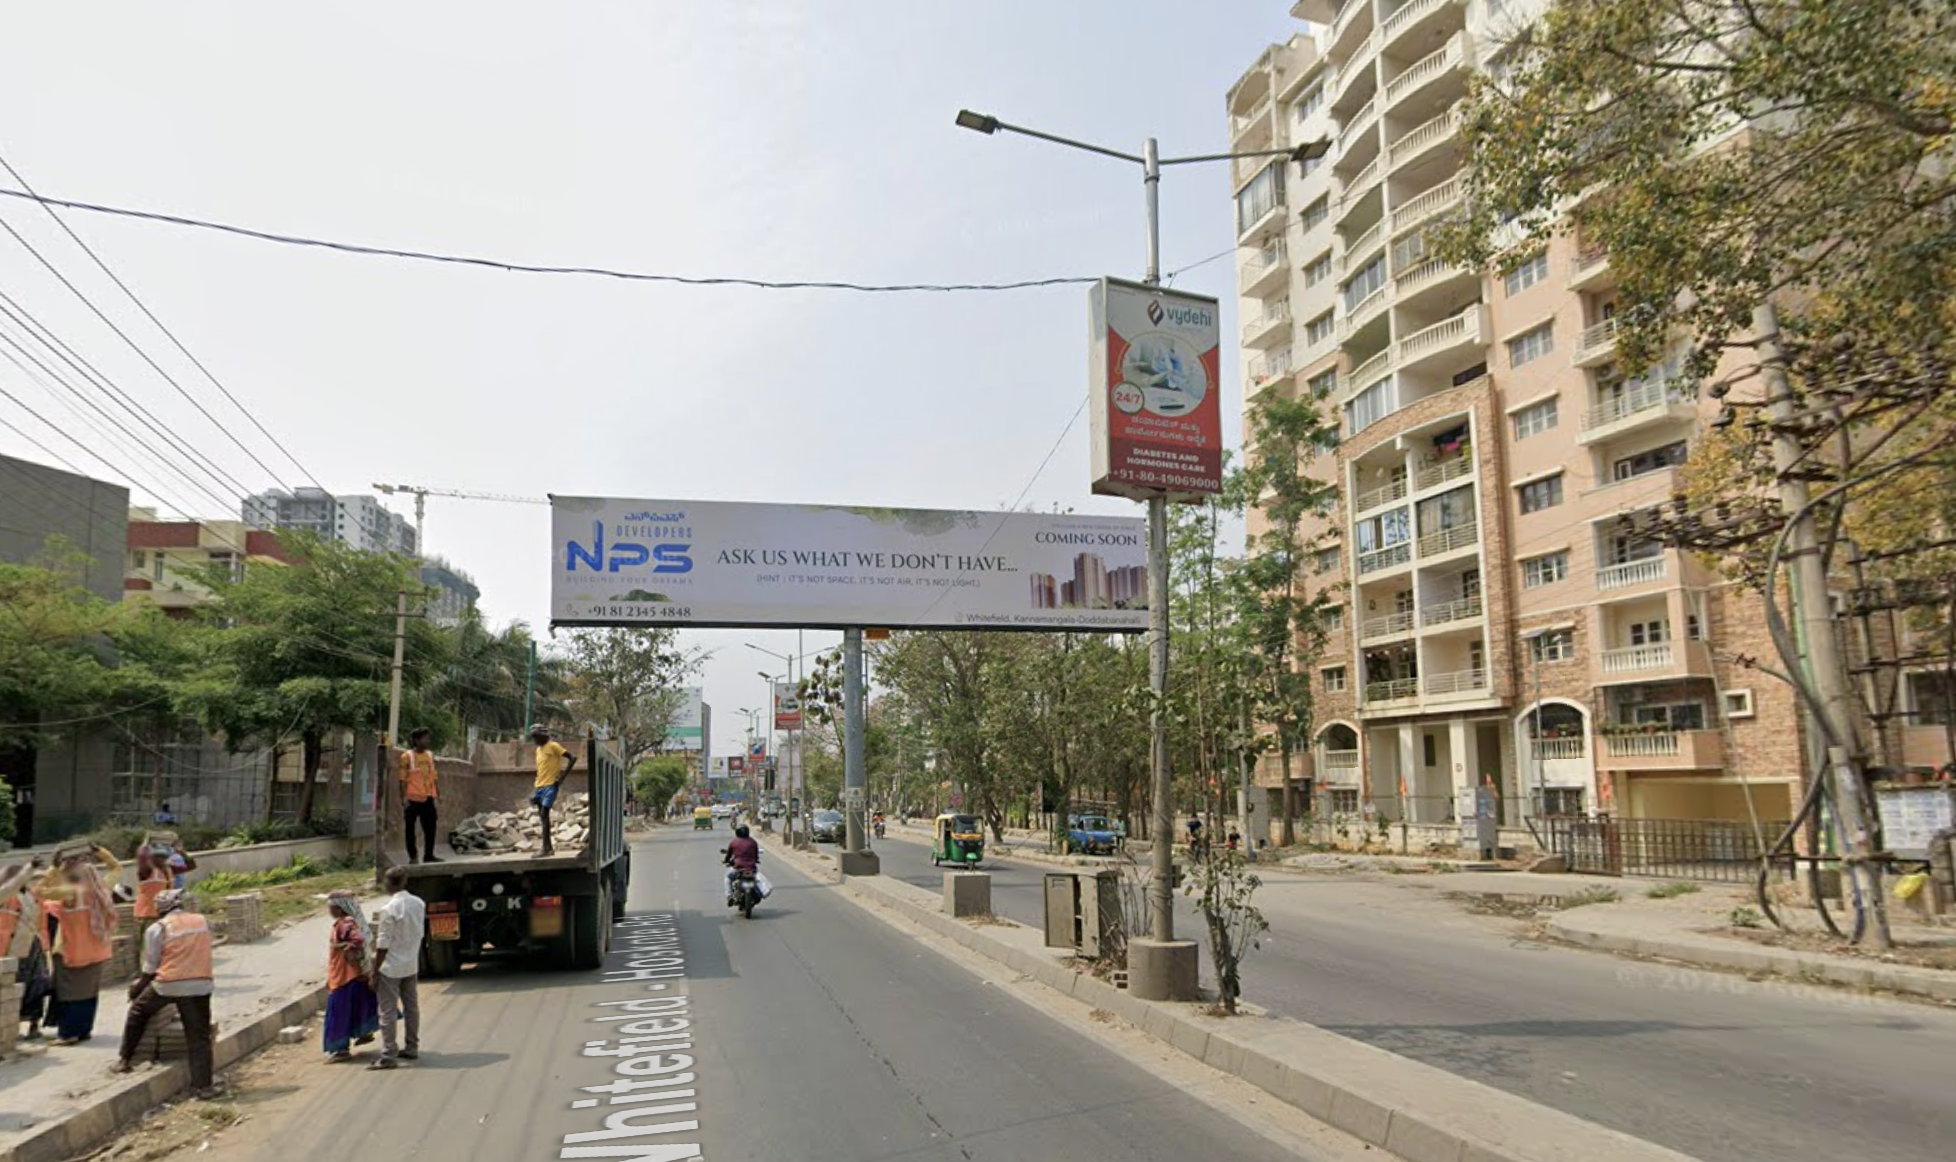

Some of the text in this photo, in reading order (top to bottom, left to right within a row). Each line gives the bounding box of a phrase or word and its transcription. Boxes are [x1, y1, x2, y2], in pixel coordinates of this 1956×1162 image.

[1166, 307, 1212, 327] vydehi
[1116, 391, 1141, 404] 24/7
[1133, 448, 1199, 463] DIABETES AND
[1127, 457, 1206, 473] HORMONES CARE
[616, 525, 693, 539] DEVELOPERS
[1035, 531, 1137, 546] COMING SOON
[566, 519, 693, 573] NPS
[717, 549, 756, 565] ASK
[762, 550, 788, 566] US
[793, 550, 851, 567] WHAT
[856, 552, 886, 568] WE
[891, 553, 953, 571] DON'T
[807, 575, 825, 584] NOT
[877, 577, 895, 586] NOT
[588, 606, 692, 617] +91 81 2345 4848
[966, 613, 1010, 624] Whitefield,
